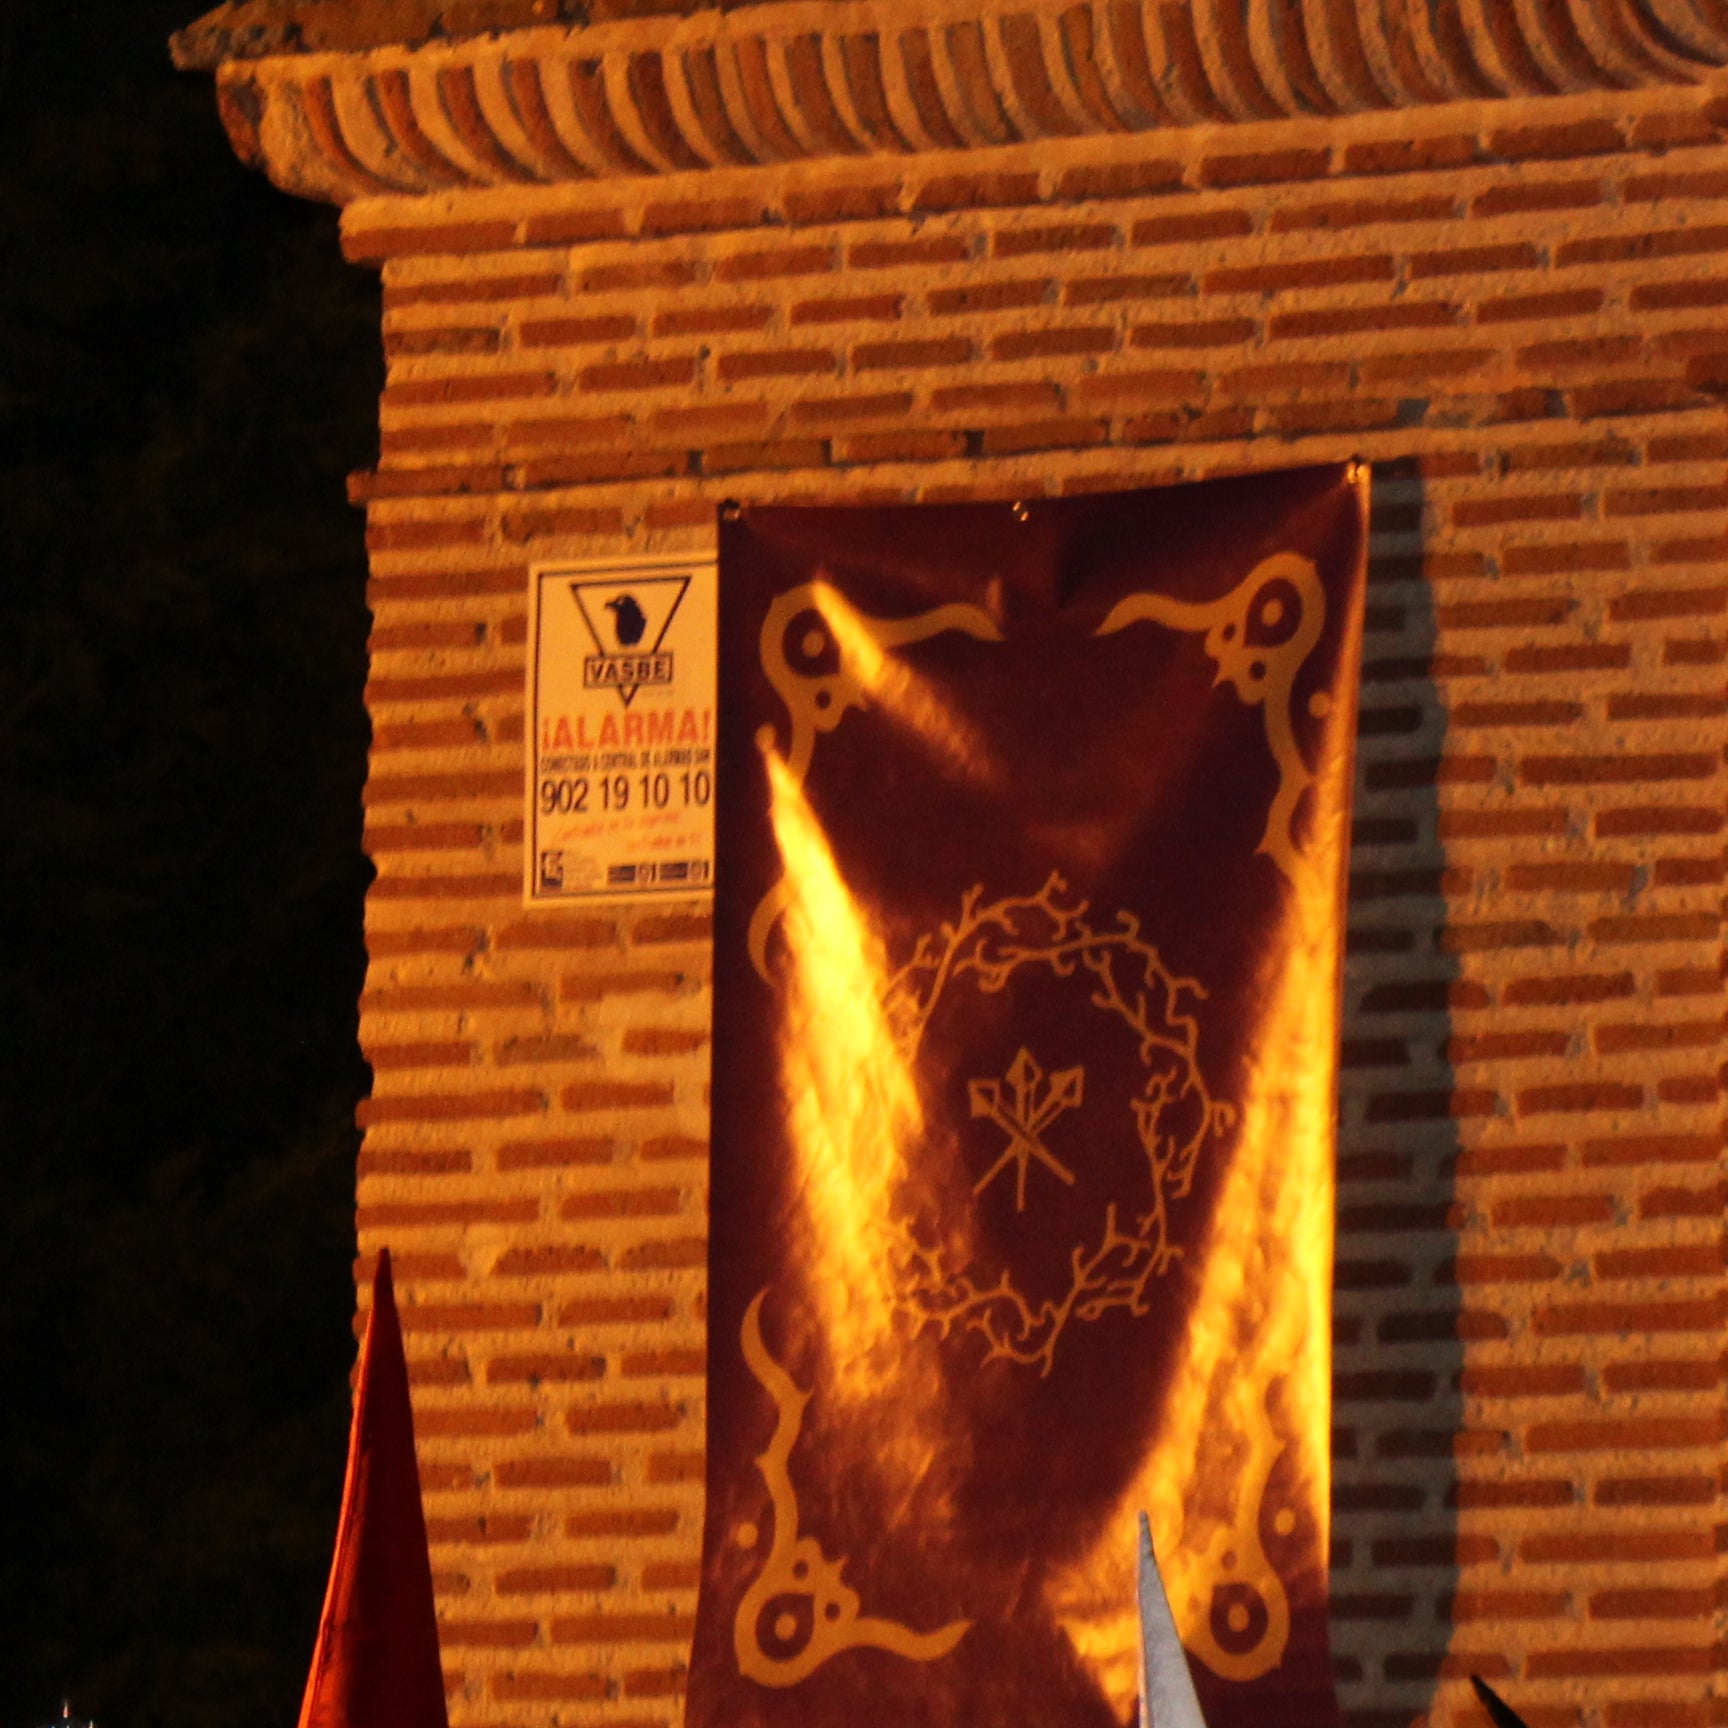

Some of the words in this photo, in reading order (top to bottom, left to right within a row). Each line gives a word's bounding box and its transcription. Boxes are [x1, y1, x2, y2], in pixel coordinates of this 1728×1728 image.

[589, 658, 667, 682] VASBE
[542, 708, 712, 750] ¡ALARMA!
[541, 779, 589, 815] 902
[601, 775, 630, 810] 19
[642, 772, 671, 808] 10
[682, 769, 711, 806] 10
